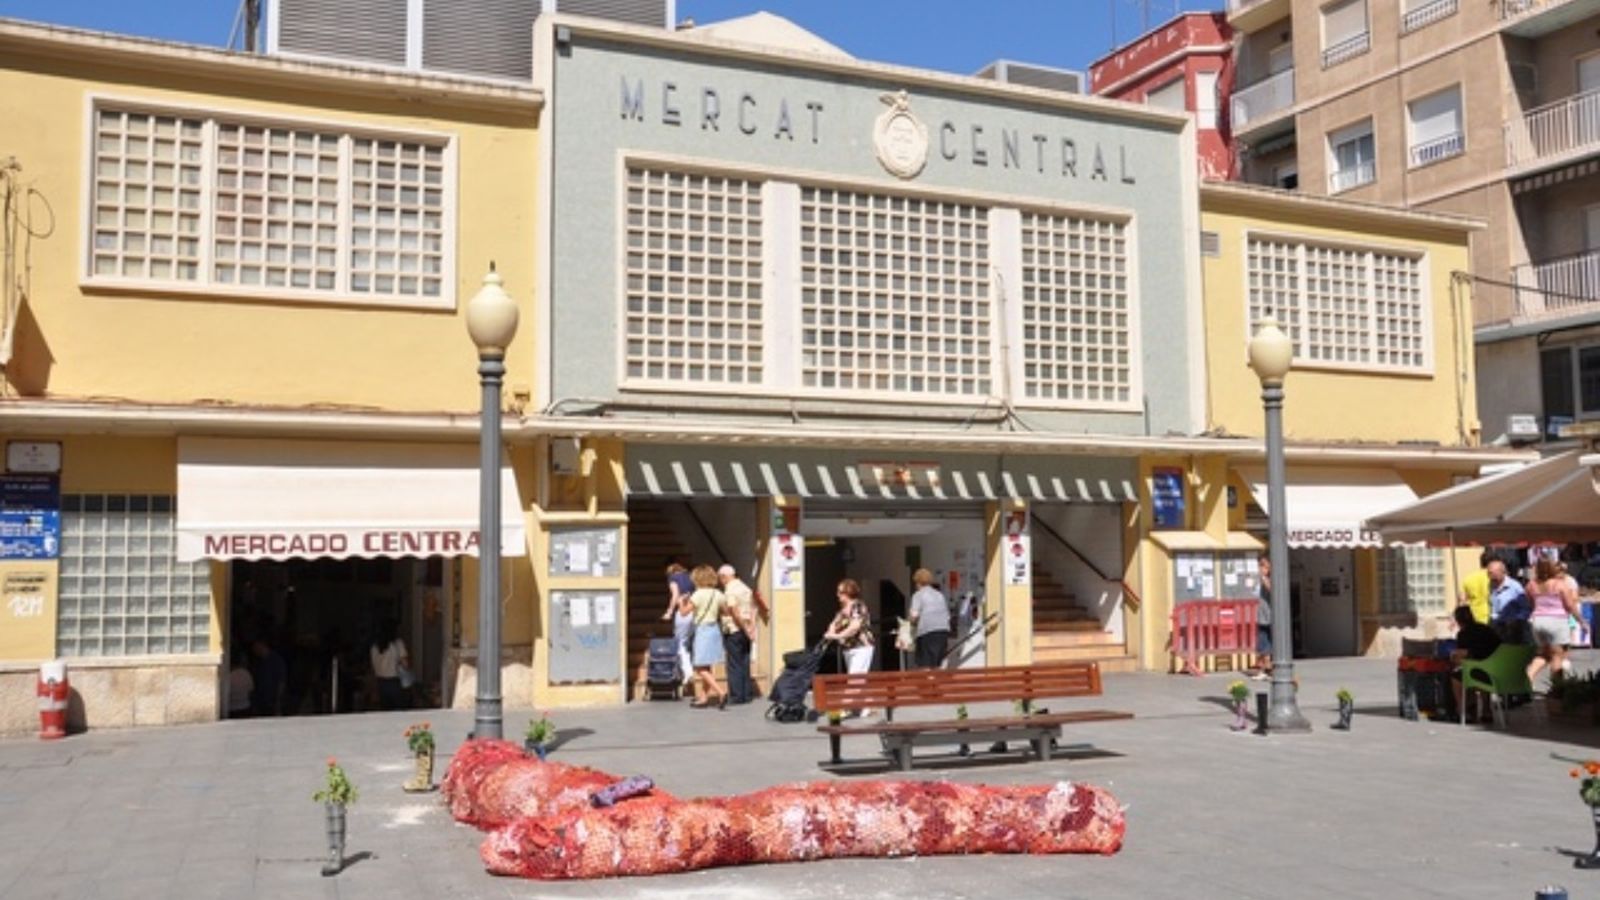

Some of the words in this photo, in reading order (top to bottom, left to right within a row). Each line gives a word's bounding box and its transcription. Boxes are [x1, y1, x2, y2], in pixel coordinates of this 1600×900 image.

[621, 76, 824, 143] MERCAT
[940, 121, 1135, 184] CENTRAL
[205, 534, 348, 553] MERCADO
[364, 531, 482, 552] CENTRA
